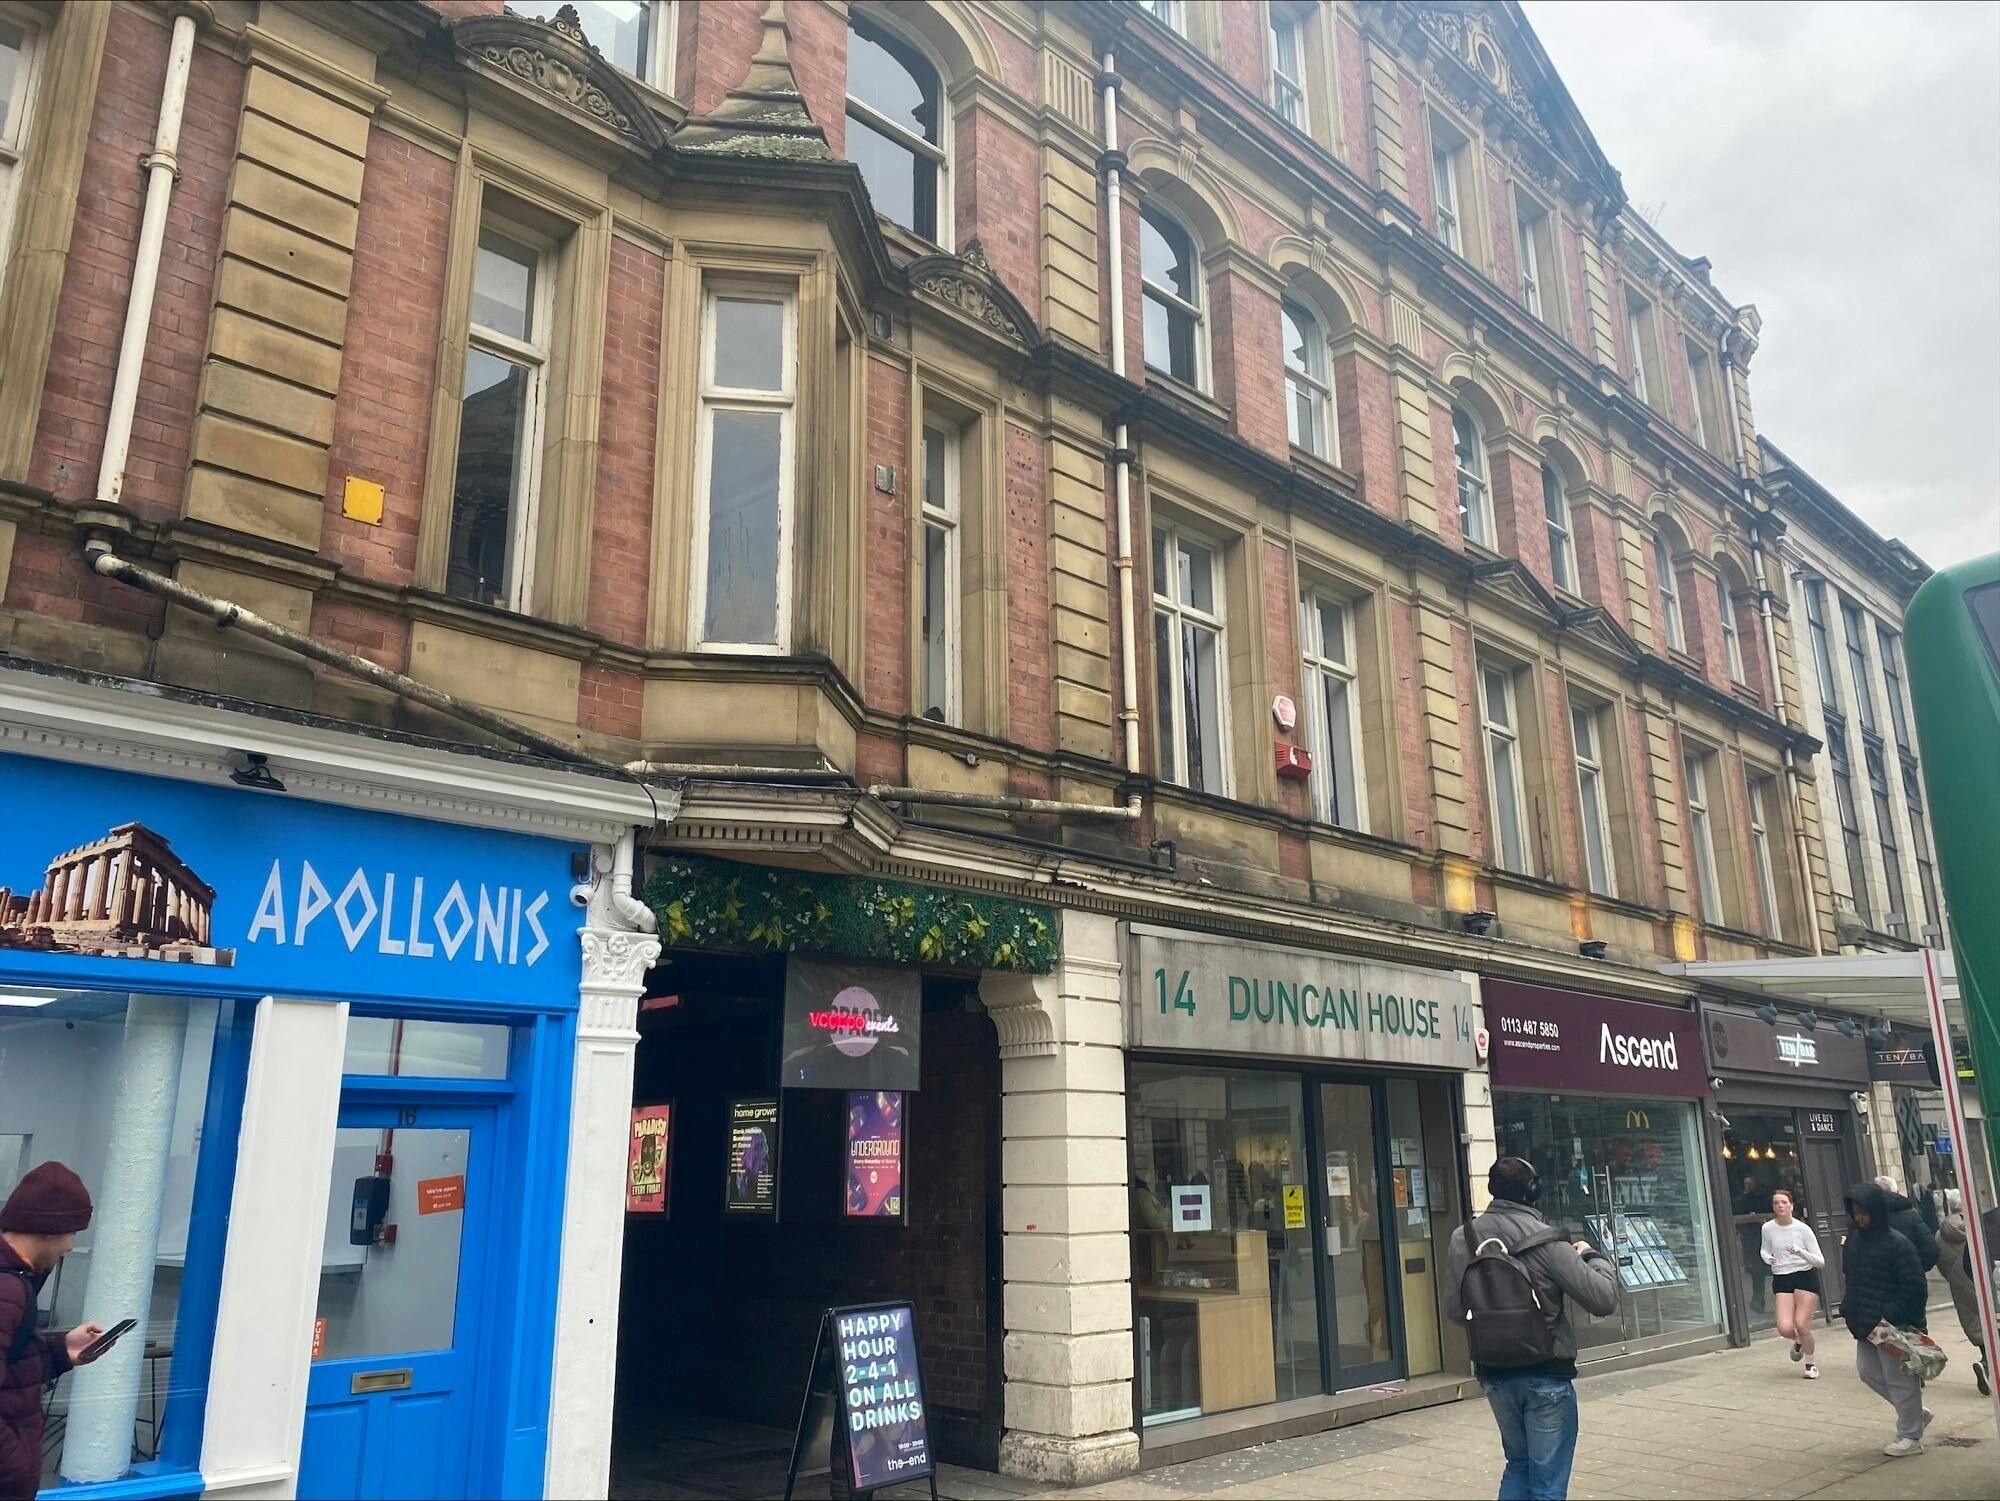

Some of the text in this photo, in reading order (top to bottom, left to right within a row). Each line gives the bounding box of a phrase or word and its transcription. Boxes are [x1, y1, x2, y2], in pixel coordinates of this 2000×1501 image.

[247, 858, 549, 967] APOLLONIS
[1155, 968, 1470, 1042] 14 DUNCAN HOUSE 14
[866, 1015, 899, 1032] events
[1501, 1017, 1559, 1038] 0113 487 5850
[1503, 1039, 1560, 1051] www.ascendproperties.com
[1600, 1022, 1678, 1070] Ascend
[734, 1108, 753, 1117] home
[1809, 1113, 1821, 1122] LIVE
[634, 1118, 667, 1138] PARADISO
[1817, 1123, 1834, 1132] DANCE
[851, 1140, 900, 1157] UNDERGROUND
[632, 1183, 661, 1196] EVERY FRIDAY
[313, 1321, 322, 1347] PUSH
[840, 1313, 901, 1338] HAPPY
[843, 1336, 896, 1361] HOUR
[846, 1358, 897, 1384] 2-4-1
[849, 1379, 915, 1407] ON ALL
[852, 1401, 921, 1431] DRINKS
